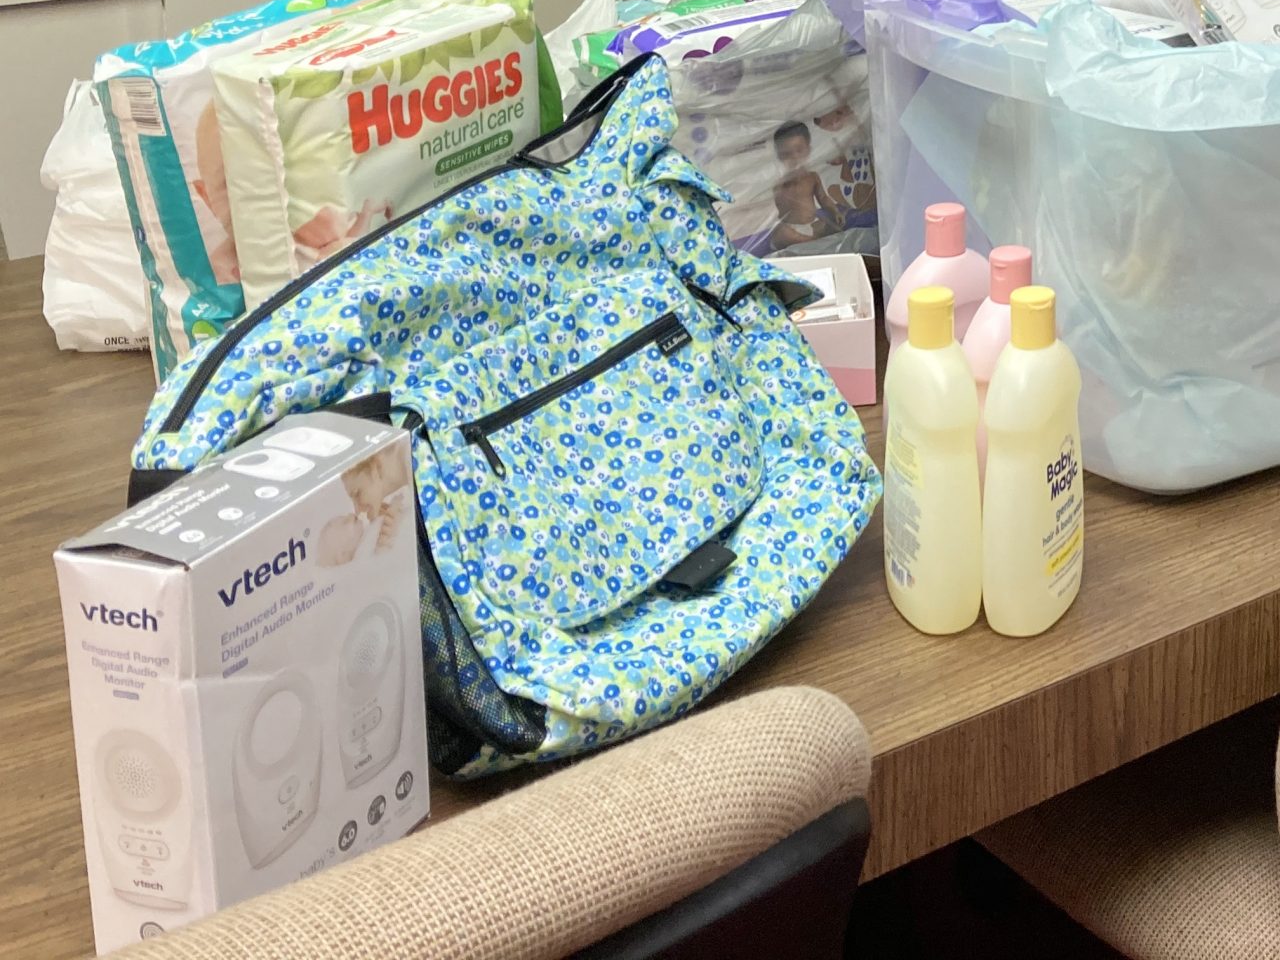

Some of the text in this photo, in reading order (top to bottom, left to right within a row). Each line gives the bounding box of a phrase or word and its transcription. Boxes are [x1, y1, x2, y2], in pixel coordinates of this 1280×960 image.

[347, 51, 523, 154] HUGGIES
[420, 102, 524, 160] natural care
[439, 144, 483, 171] SENSITIVE
[484, 134, 510, 155] WIPES
[104, 336, 130, 346] ONCE
[1047, 450, 1073, 483] Baby
[1051, 461, 1078, 501] Magic
[218, 538, 307, 608] vtech
[80, 602, 158, 632] vtech
[220, 581, 315, 646] Enhanced Range
[221, 583, 336, 663] Digital Audio Monitor
[91, 656, 159, 679] Digital Audio
[133, 650, 171, 668] Range
[104, 673, 146, 690] Monitor
[133, 879, 164, 892] vtech
